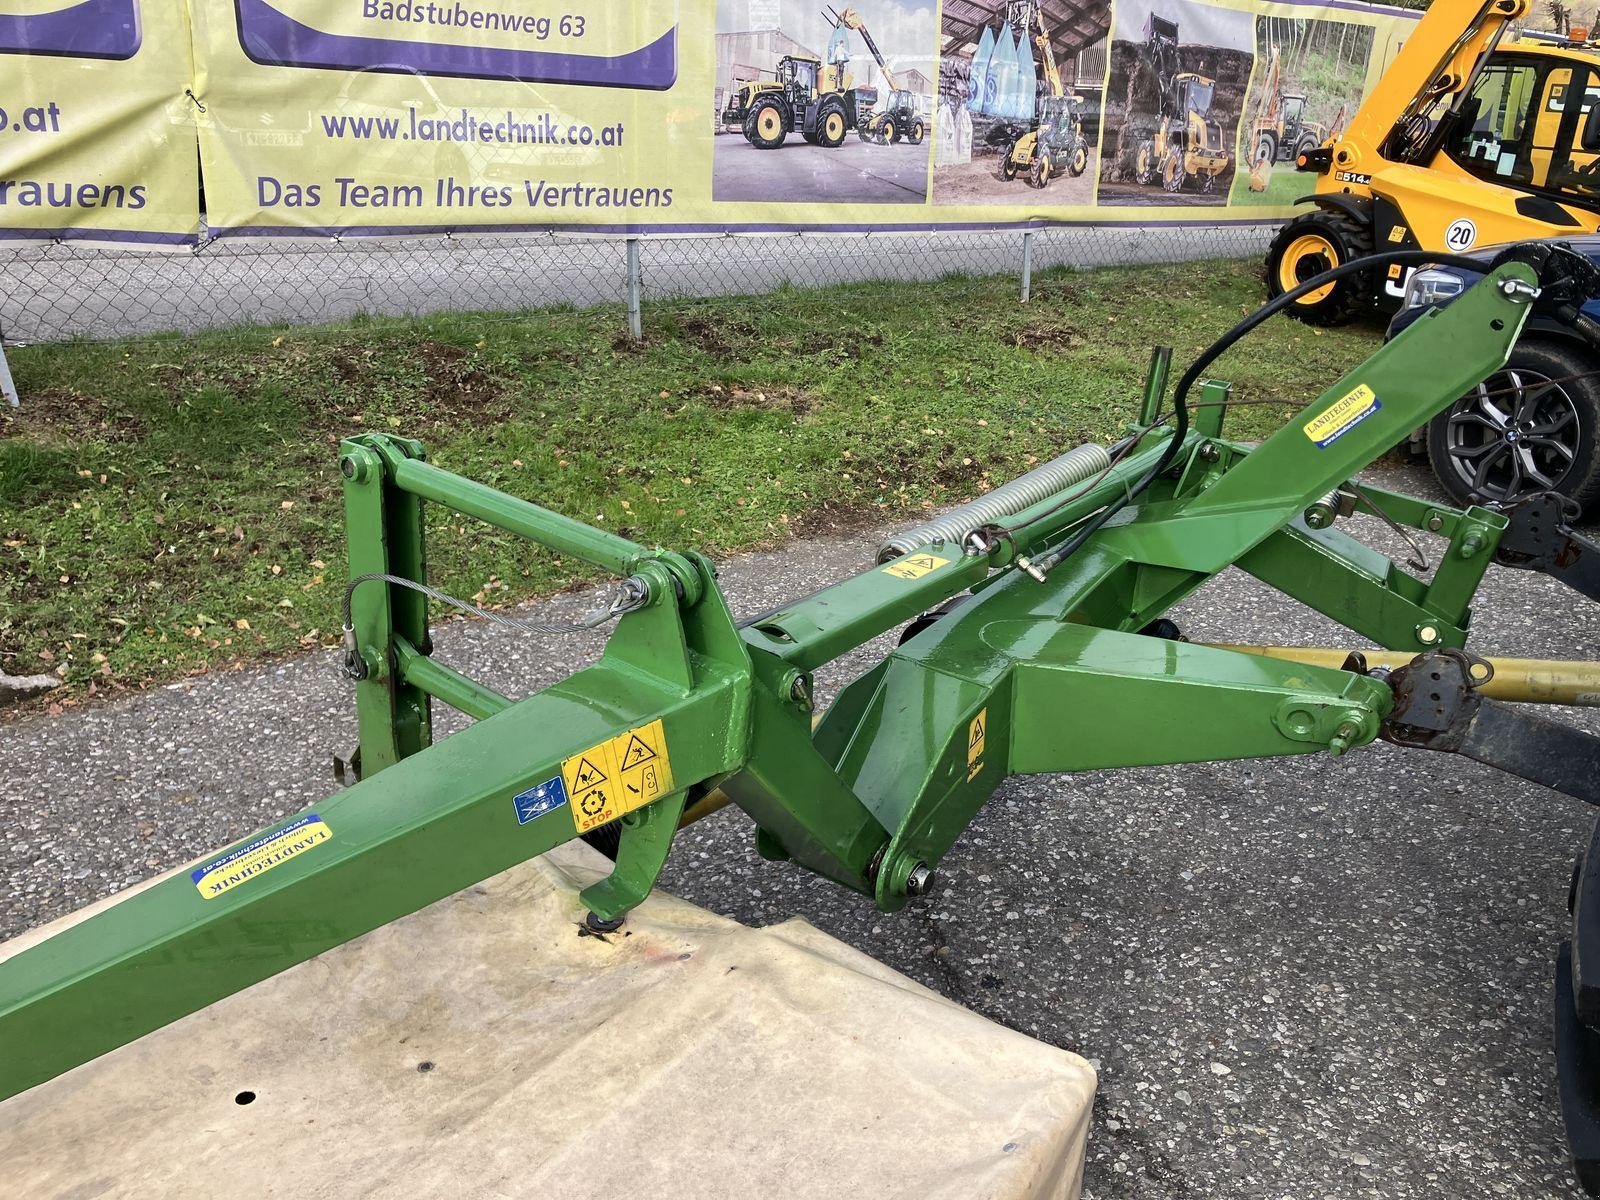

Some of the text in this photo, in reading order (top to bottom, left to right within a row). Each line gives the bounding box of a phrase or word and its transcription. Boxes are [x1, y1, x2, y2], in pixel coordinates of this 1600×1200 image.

[363, 0, 586, 40] Badstubenweg 63
[321, 107, 624, 146] www.landtechnik.co.at
[257, 176, 673, 208] Das Team Ihres Vertrauens
[1450, 226, 1471, 244] 20
[1307, 388, 1366, 434] LANDTECHNIK
[582, 809, 613, 829] STOP
[202, 818, 309, 873] www.landtechnik.co.at
[210, 831, 327, 893] LANDTECHNIK
